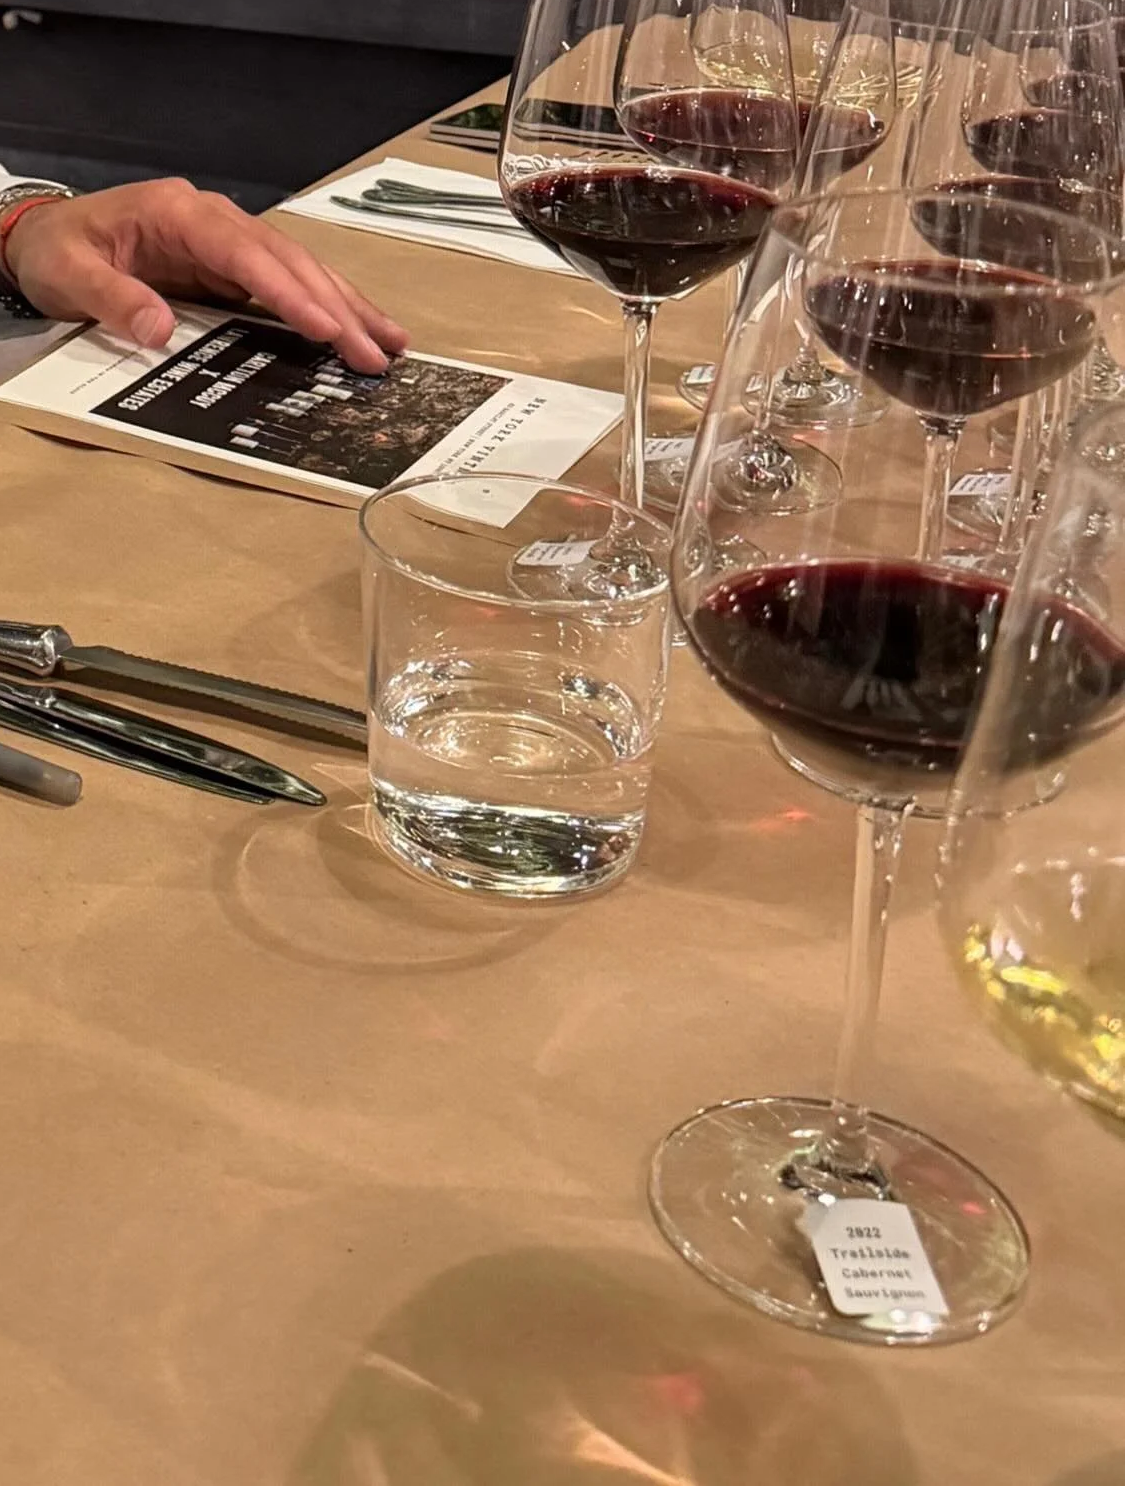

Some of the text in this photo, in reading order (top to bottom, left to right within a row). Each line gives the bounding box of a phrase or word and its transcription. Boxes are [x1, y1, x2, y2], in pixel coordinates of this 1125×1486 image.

[187, 328, 250, 363] LAWRENCE
[161, 360, 201, 382] WINE
[198, 368, 221, 378] X
[223, 351, 277, 384] CARLTON
[118, 378, 174, 411] ESTATES
[521, 397, 547, 416] NEW
[491, 418, 524, 442] YORK
[846, 1226, 882, 1239] 2022
[829, 1247, 911, 1260] Trailside
[841, 1267, 913, 1280] Cabernet
[844, 1288, 927, 1301] Sauvignon
